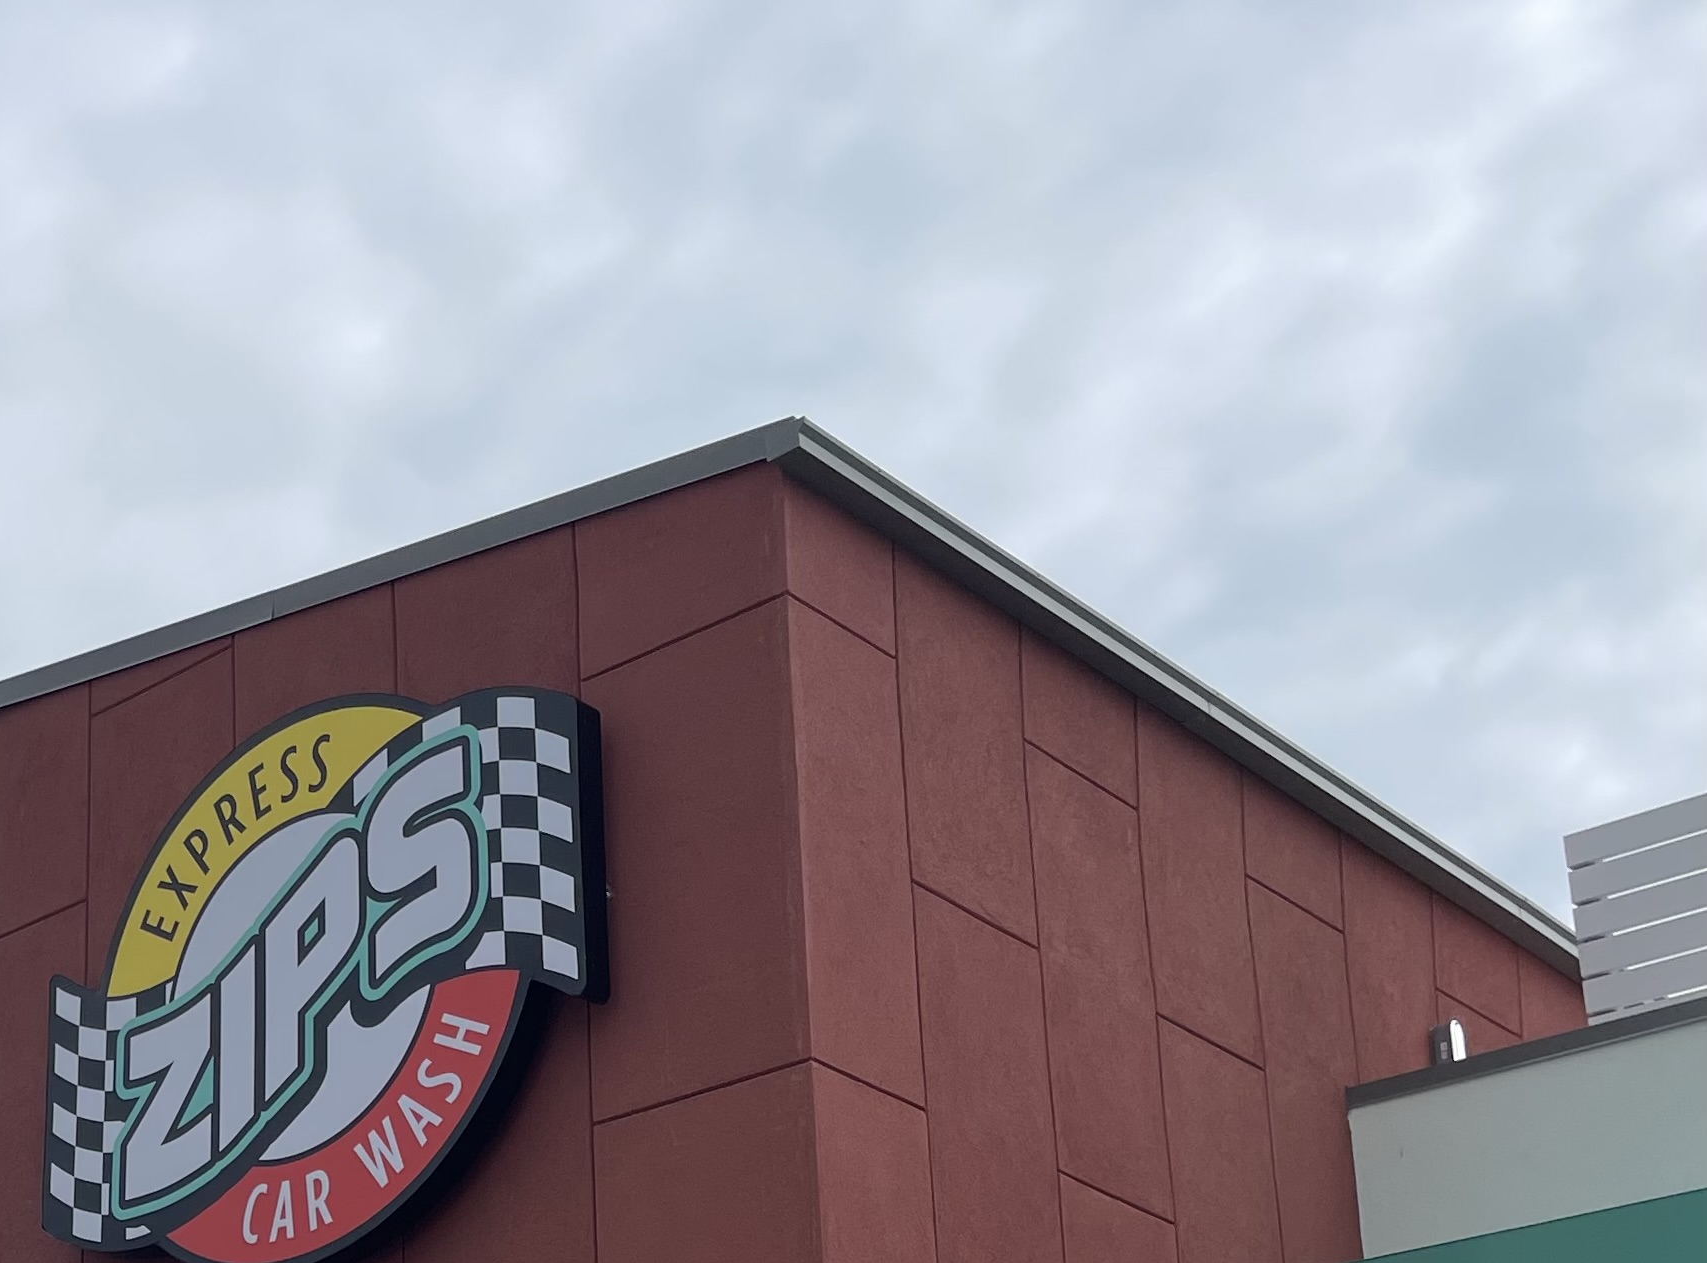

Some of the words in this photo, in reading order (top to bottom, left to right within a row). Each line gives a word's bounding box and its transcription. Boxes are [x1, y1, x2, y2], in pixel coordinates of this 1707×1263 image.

[140, 734, 331, 943] EXPRESS
[122, 742, 474, 1202] ZIPS
[241, 1169, 333, 1245] CAR
[353, 1012, 491, 1189] WASH
